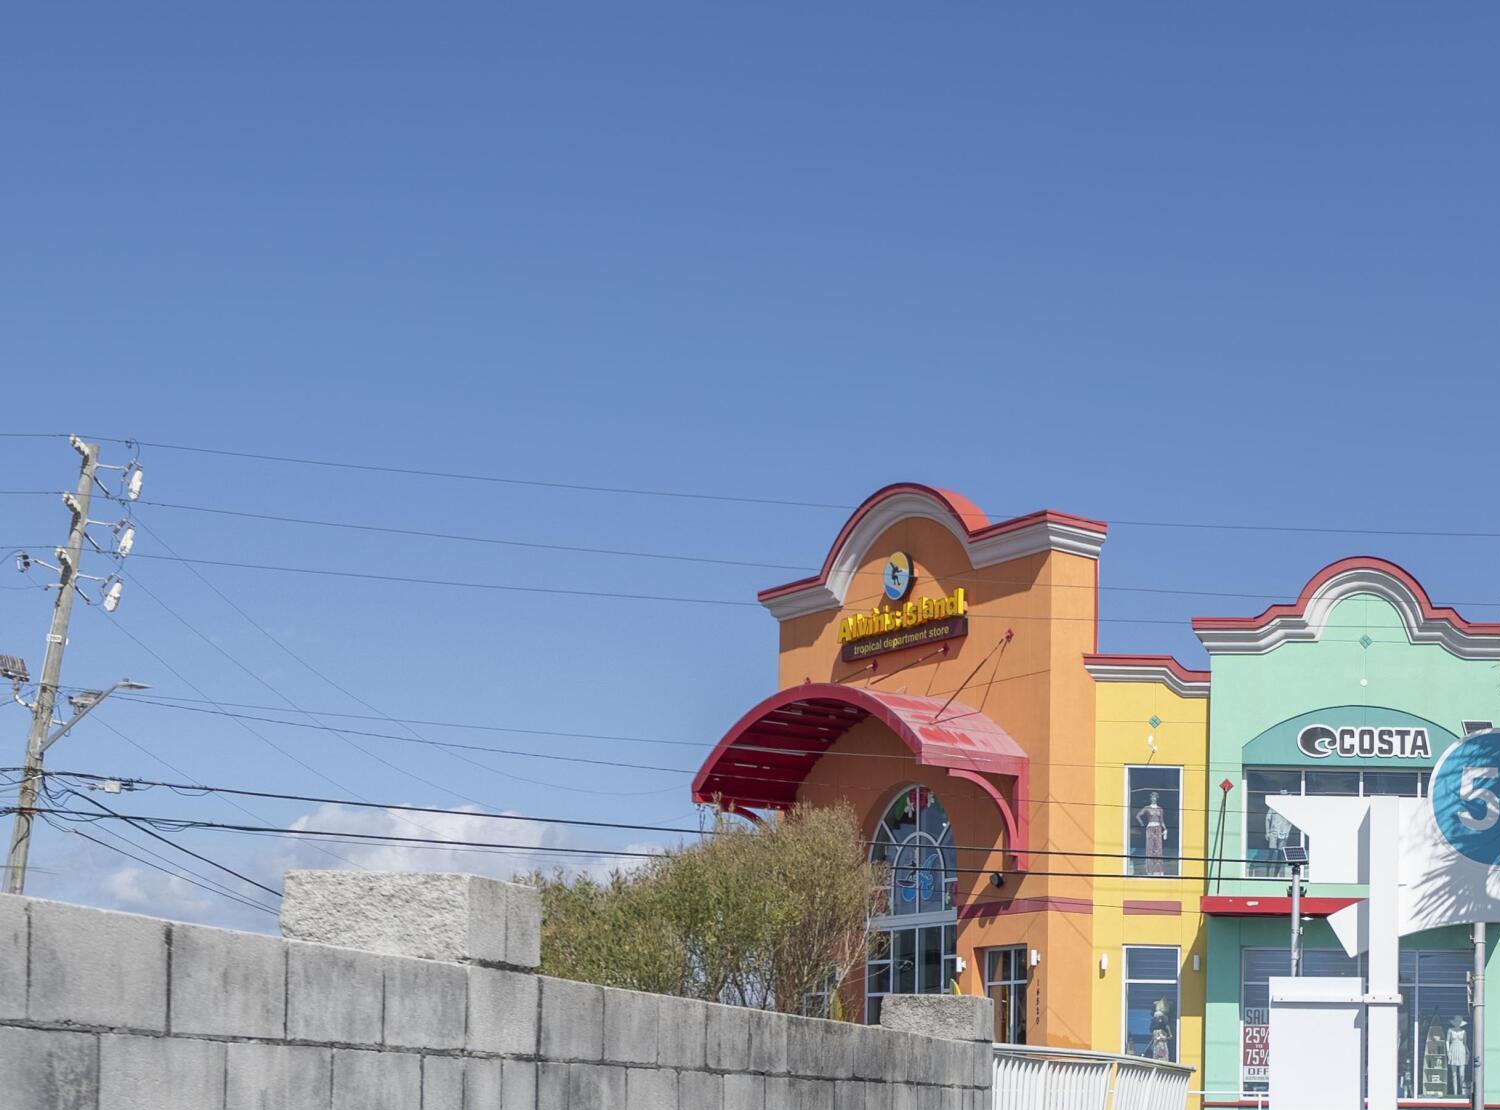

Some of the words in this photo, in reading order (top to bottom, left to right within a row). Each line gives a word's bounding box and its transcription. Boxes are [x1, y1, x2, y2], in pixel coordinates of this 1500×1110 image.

[853, 639, 882, 655] tropical
[883, 629, 928, 648] department
[928, 624, 950, 639] store
[1338, 727, 1431, 757] COSTA
